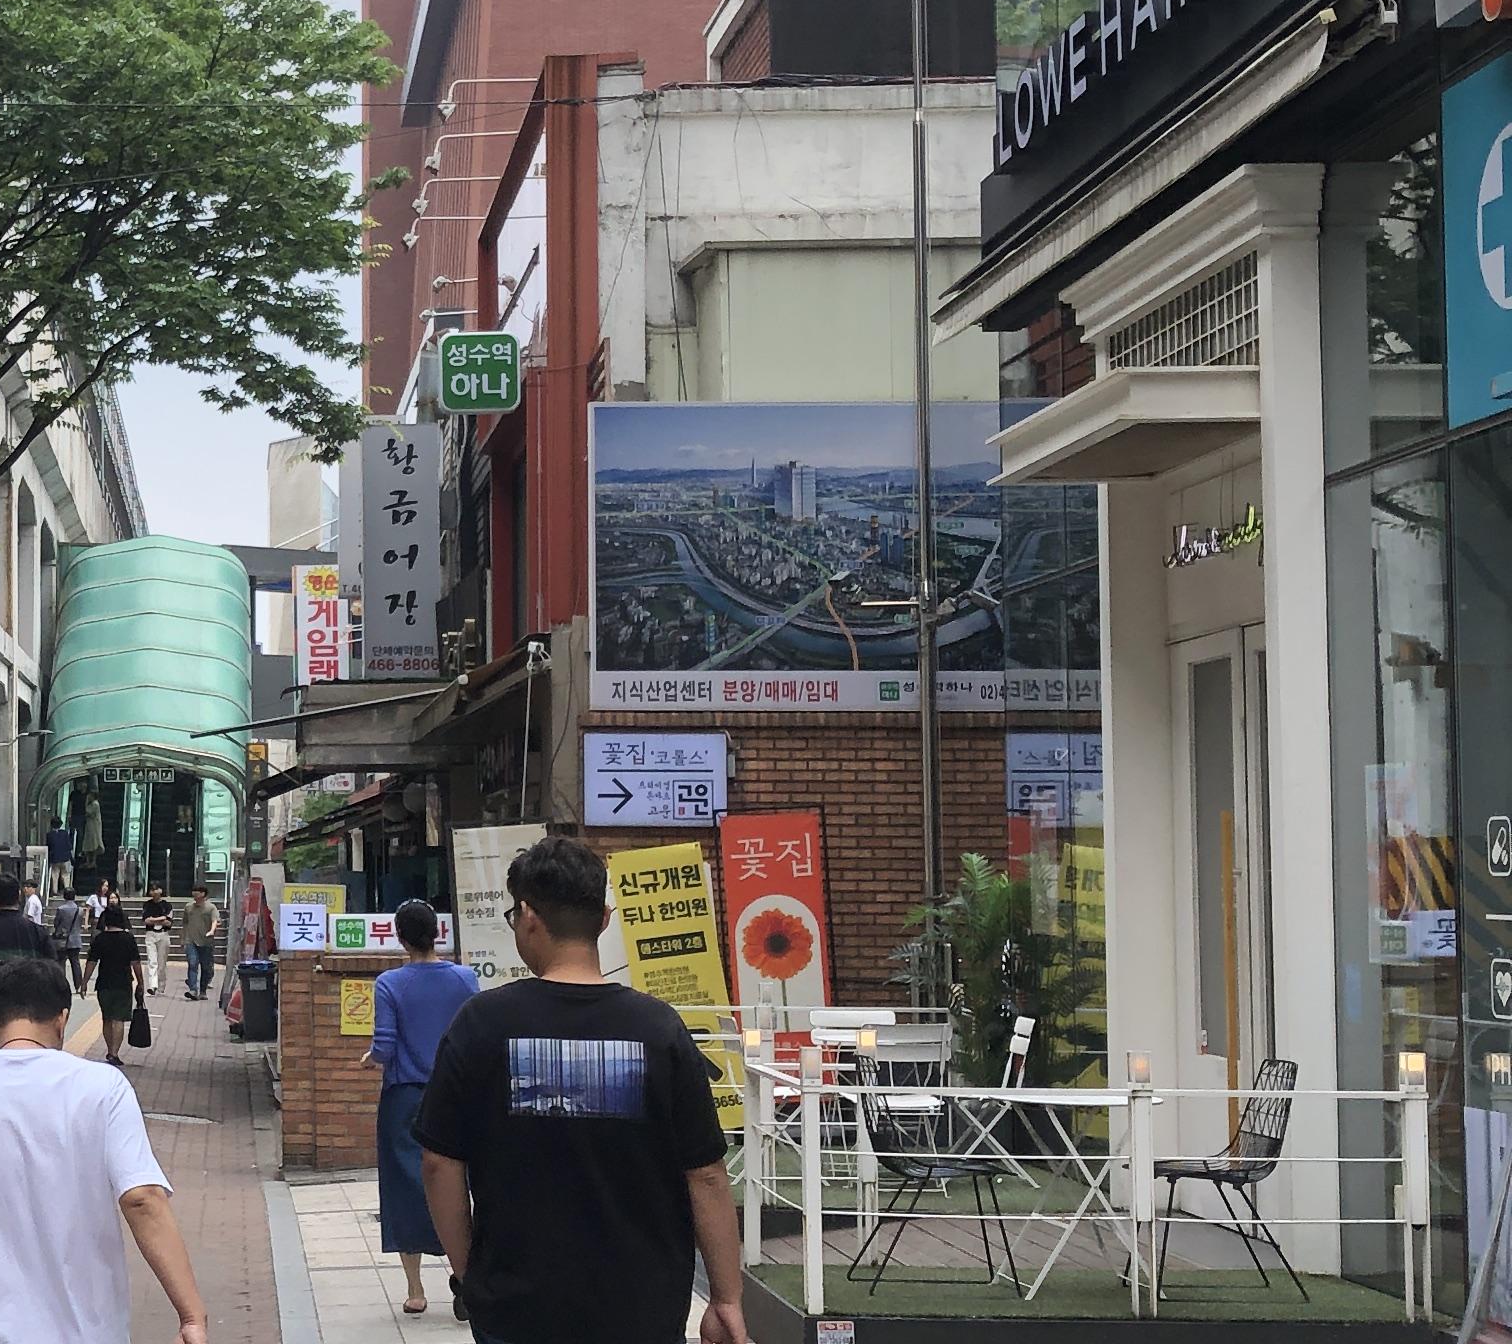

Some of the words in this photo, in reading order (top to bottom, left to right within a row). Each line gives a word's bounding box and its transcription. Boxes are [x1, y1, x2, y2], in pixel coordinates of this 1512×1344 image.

[998, 13, 1087, 166] LOWE
[447, 342, 513, 366] 성수역
[450, 371, 511, 400] 하나
[381, 438, 419, 626] 황금어장
[307, 600, 339, 685] 게임랜
[612, 680, 712, 702] 지식산업센터
[722, 680, 839, 702] 분양/매매/임대
[602, 741, 646, 766] 꽃집
[730, 832, 814, 881] 꽃집
[619, 864, 703, 897] 신규개원
[463, 890, 504, 903] 로위헤어
[465, 907, 496, 919] 성수점
[623, 905, 656, 926] 두나
[658, 897, 709, 922] 한의원
[287, 912, 320, 943] 꽃
[338, 921, 365, 932] 성수역
[338, 932, 364, 945] 하나
[685, 935, 703, 950] 2층
